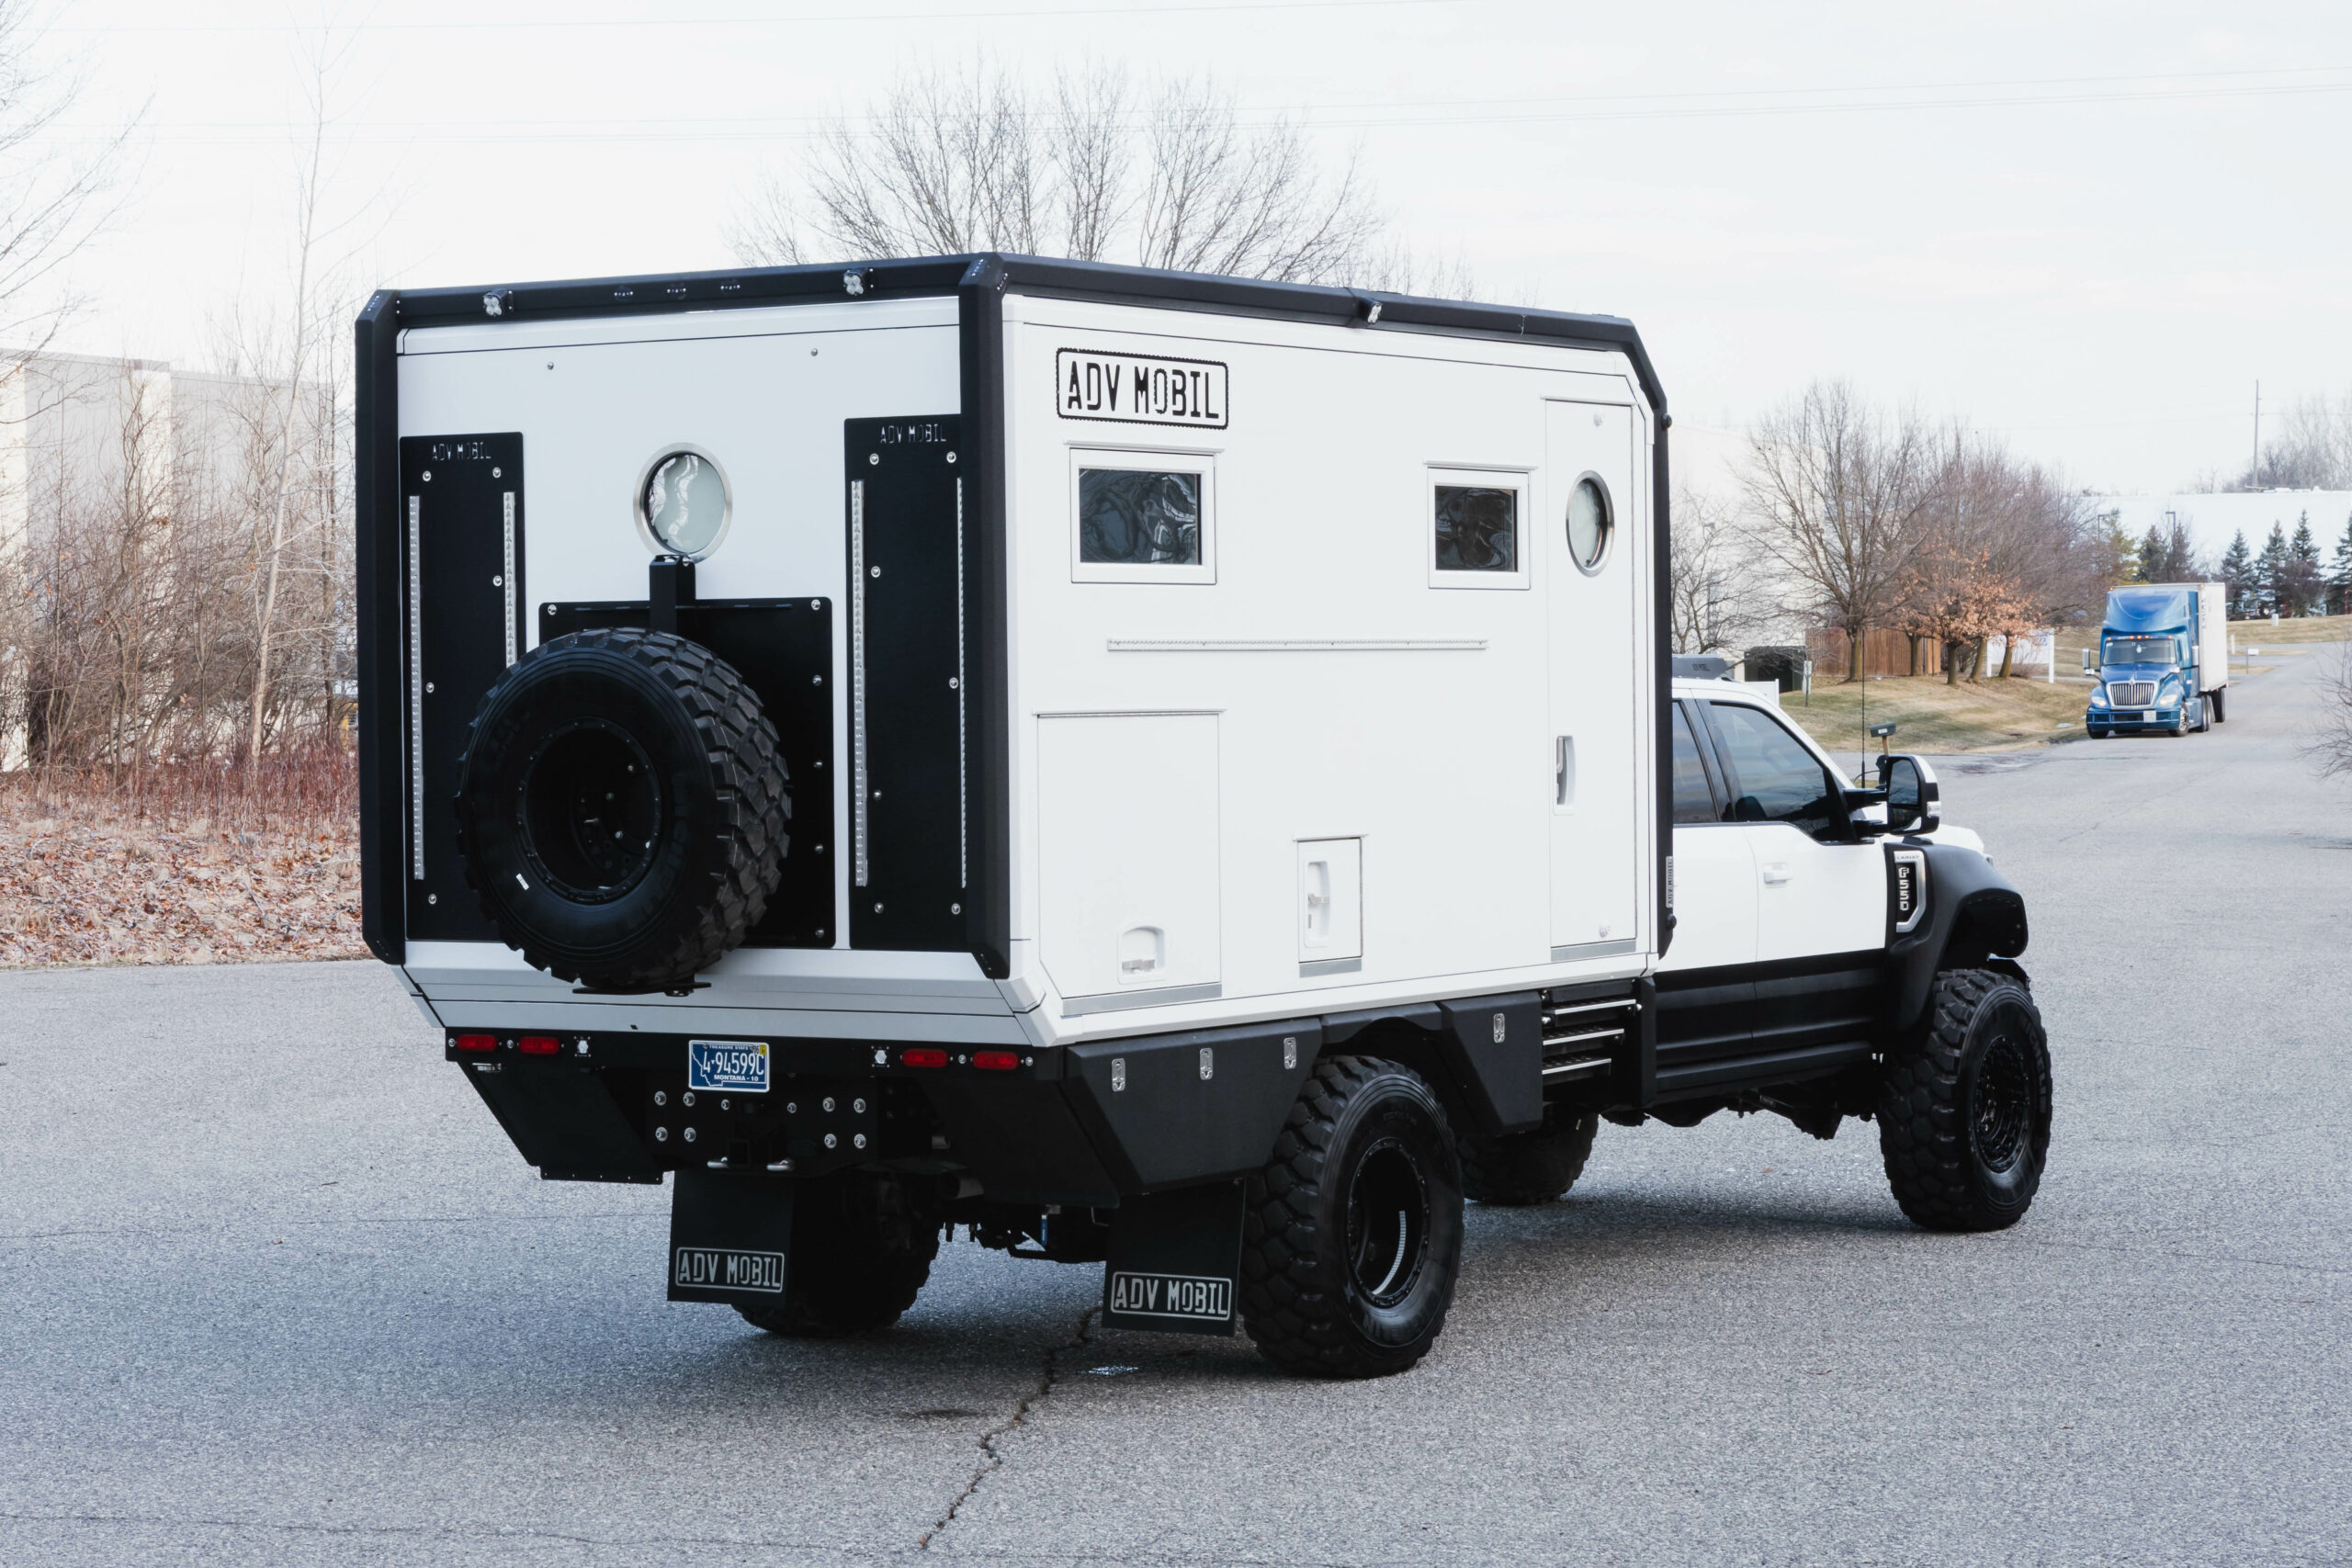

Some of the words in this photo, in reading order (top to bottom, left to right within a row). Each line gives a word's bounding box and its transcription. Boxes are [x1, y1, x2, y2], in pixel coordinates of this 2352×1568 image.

[1068, 361, 1121, 412] ADV
[1135, 366, 1219, 419] MOBIL
[432, 443, 452, 461] ADV
[880, 425, 902, 444] ADV
[1898, 866, 1910, 911] F550
[679, 1252, 718, 1283] ADV
[727, 1255, 781, 1288] MOBIL
[1114, 1277, 1159, 1310] ADV
[1167, 1280, 1227, 1314] MOBIL
